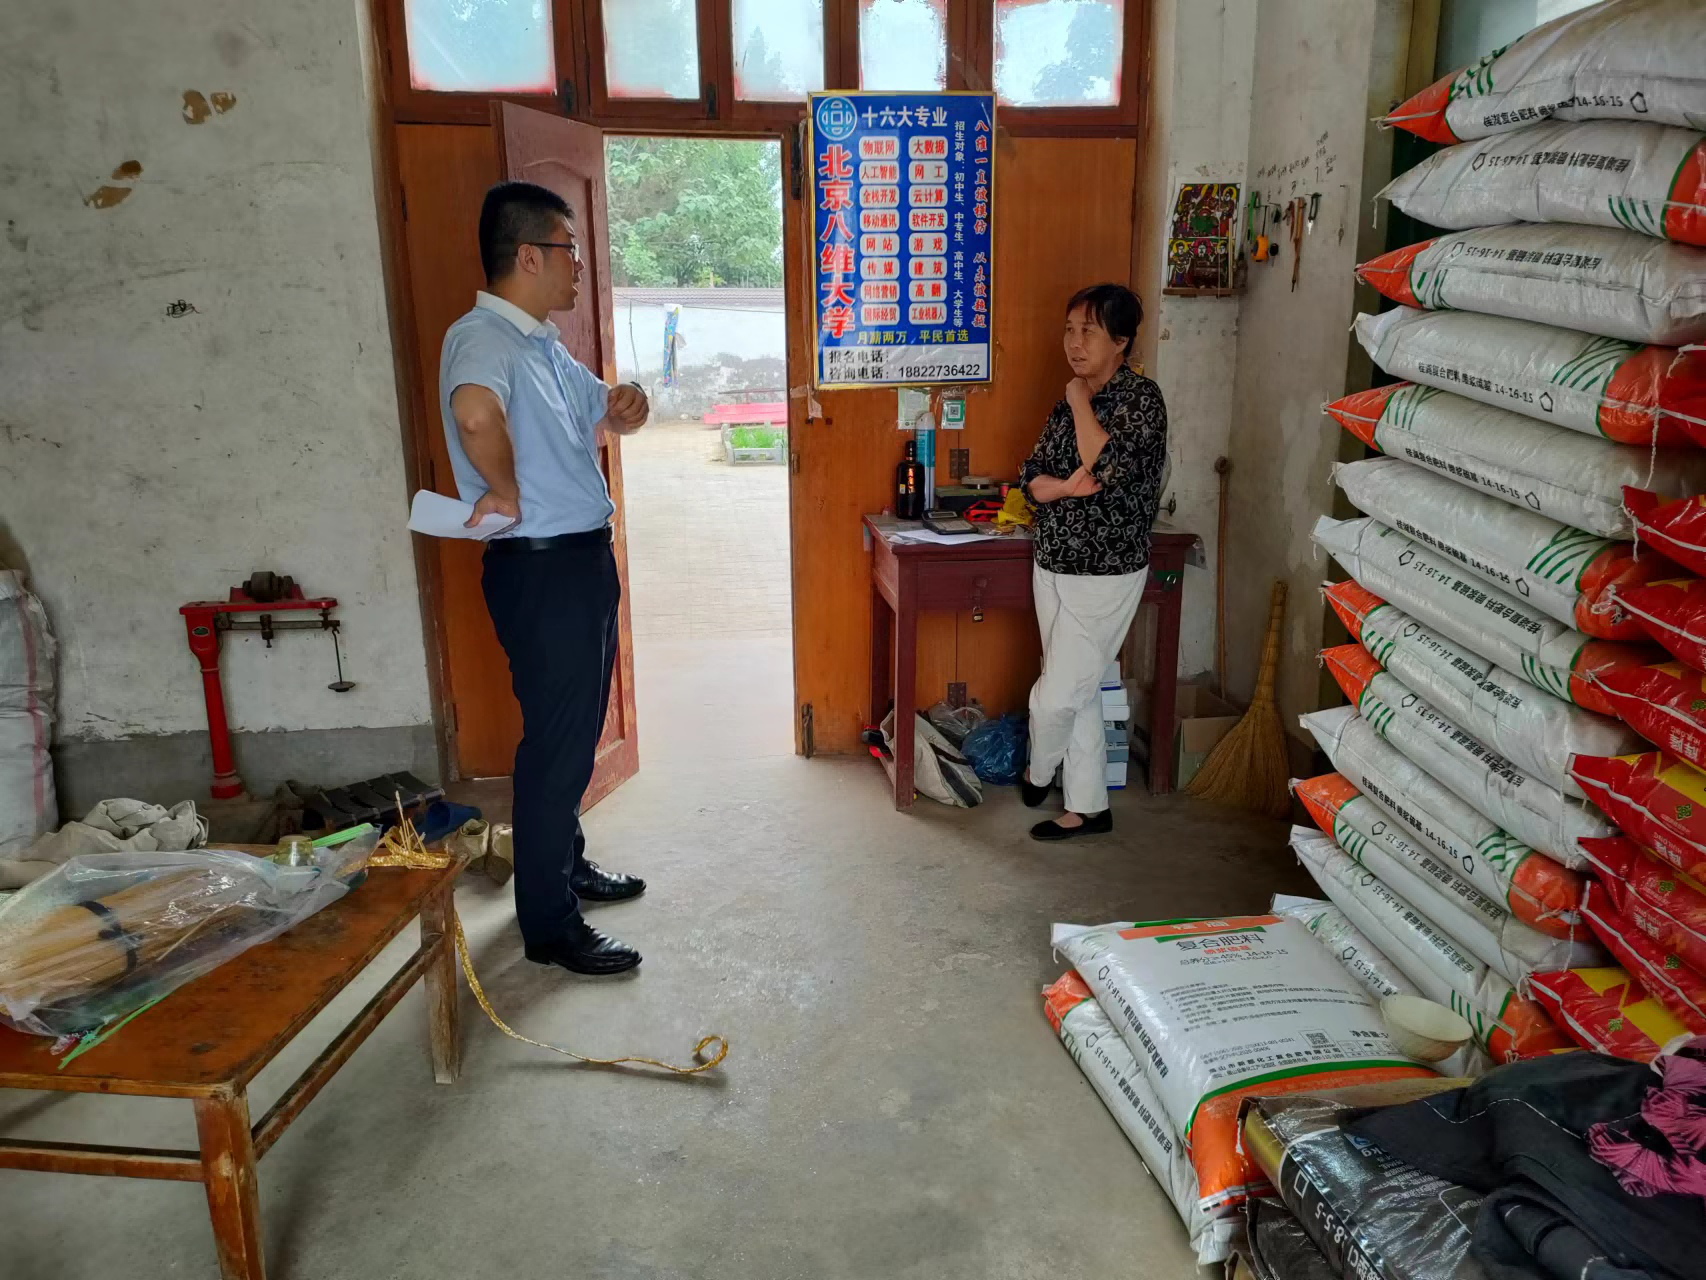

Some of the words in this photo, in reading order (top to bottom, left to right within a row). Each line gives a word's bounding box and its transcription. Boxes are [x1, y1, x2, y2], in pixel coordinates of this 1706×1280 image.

[862, 105, 948, 128] 十六大专业
[863, 140, 895, 155] 物联网
[913, 140, 945, 154] 大数据
[1488, 153, 1528, 168] 14-16-15
[862, 164, 897, 180] 人工智能
[974, 119, 989, 235] 八维一直被模仿
[1569, 153, 1630, 173] 桂湖复合肥料
[863, 188, 897, 204] 全栈开发
[913, 188, 944, 204] 云计算
[863, 213, 897, 228] 移动通讯
[912, 212, 945, 228] 软件开发
[818, 144, 856, 338] 北京八维大学
[1465, 245, 1504, 258] 14-16-15
[1543, 250, 1602, 270] 桂湖复合肥料
[864, 284, 897, 300] 网络营销
[971, 251, 988, 328] 从未被超越
[864, 306, 897, 322] 国际经贸
[911, 306, 944, 321] 工业机器人
[857, 331, 908, 345] 月薪两万
[919, 329, 970, 343] 平民首选
[898, 363, 981, 378] 18822736422
[1418, 361, 1460, 384] 桂湖复合肥料
[1494, 382, 1533, 404] 14-16-15
[1405, 446, 1447, 471] 桂湖复合肥料
[1447, 461, 1480, 485] 喷浆硫基
[1481, 475, 1520, 500] 14-16-15
[1396, 518, 1438, 549] 桂湖复合肥料
[1437, 540, 1468, 565] 喷浆硫基
[1470, 556, 1511, 585] 14-16-15
[1413, 560, 1452, 587] 14-16-15
[1451, 578, 1491, 606] 喷浆硫基
[1483, 590, 1542, 635] 桂湖复合肥料
[1417, 632, 1452, 660] 14-16-15
[1414, 704, 1452, 731] 14-16-15
[1362, 775, 1397, 813] 桂湖复合肥料
[1396, 803, 1424, 834] 喷浆硫基
[1423, 826, 1459, 860] 14-16-15
[1384, 832, 1422, 863] 14-16-15
[1418, 853, 1457, 884] 喷浆硫基
[1371, 884, 1405, 913] 14-16-15
[1451, 873, 1502, 919] 桂湖复合肥料
[1403, 910, 1433, 938] 喷浆硫基
[1176, 933, 1266, 952] 复合肥料
[1245, 949, 1289, 957] 14-16-15
[1430, 932, 1474, 973] 桂湖复合肥料
[1351, 959, 1387, 992] 14-16-15
[1106, 977, 1128, 1009] 14-16-15
[1094, 1045, 1120, 1079] 14-16-15
[1139, 1028, 1168, 1079] 桂湖复合肥料
[1117, 1075, 1142, 1110] 喷浆硫基
[1138, 1103, 1173, 1155] 桂湖复合肥料
